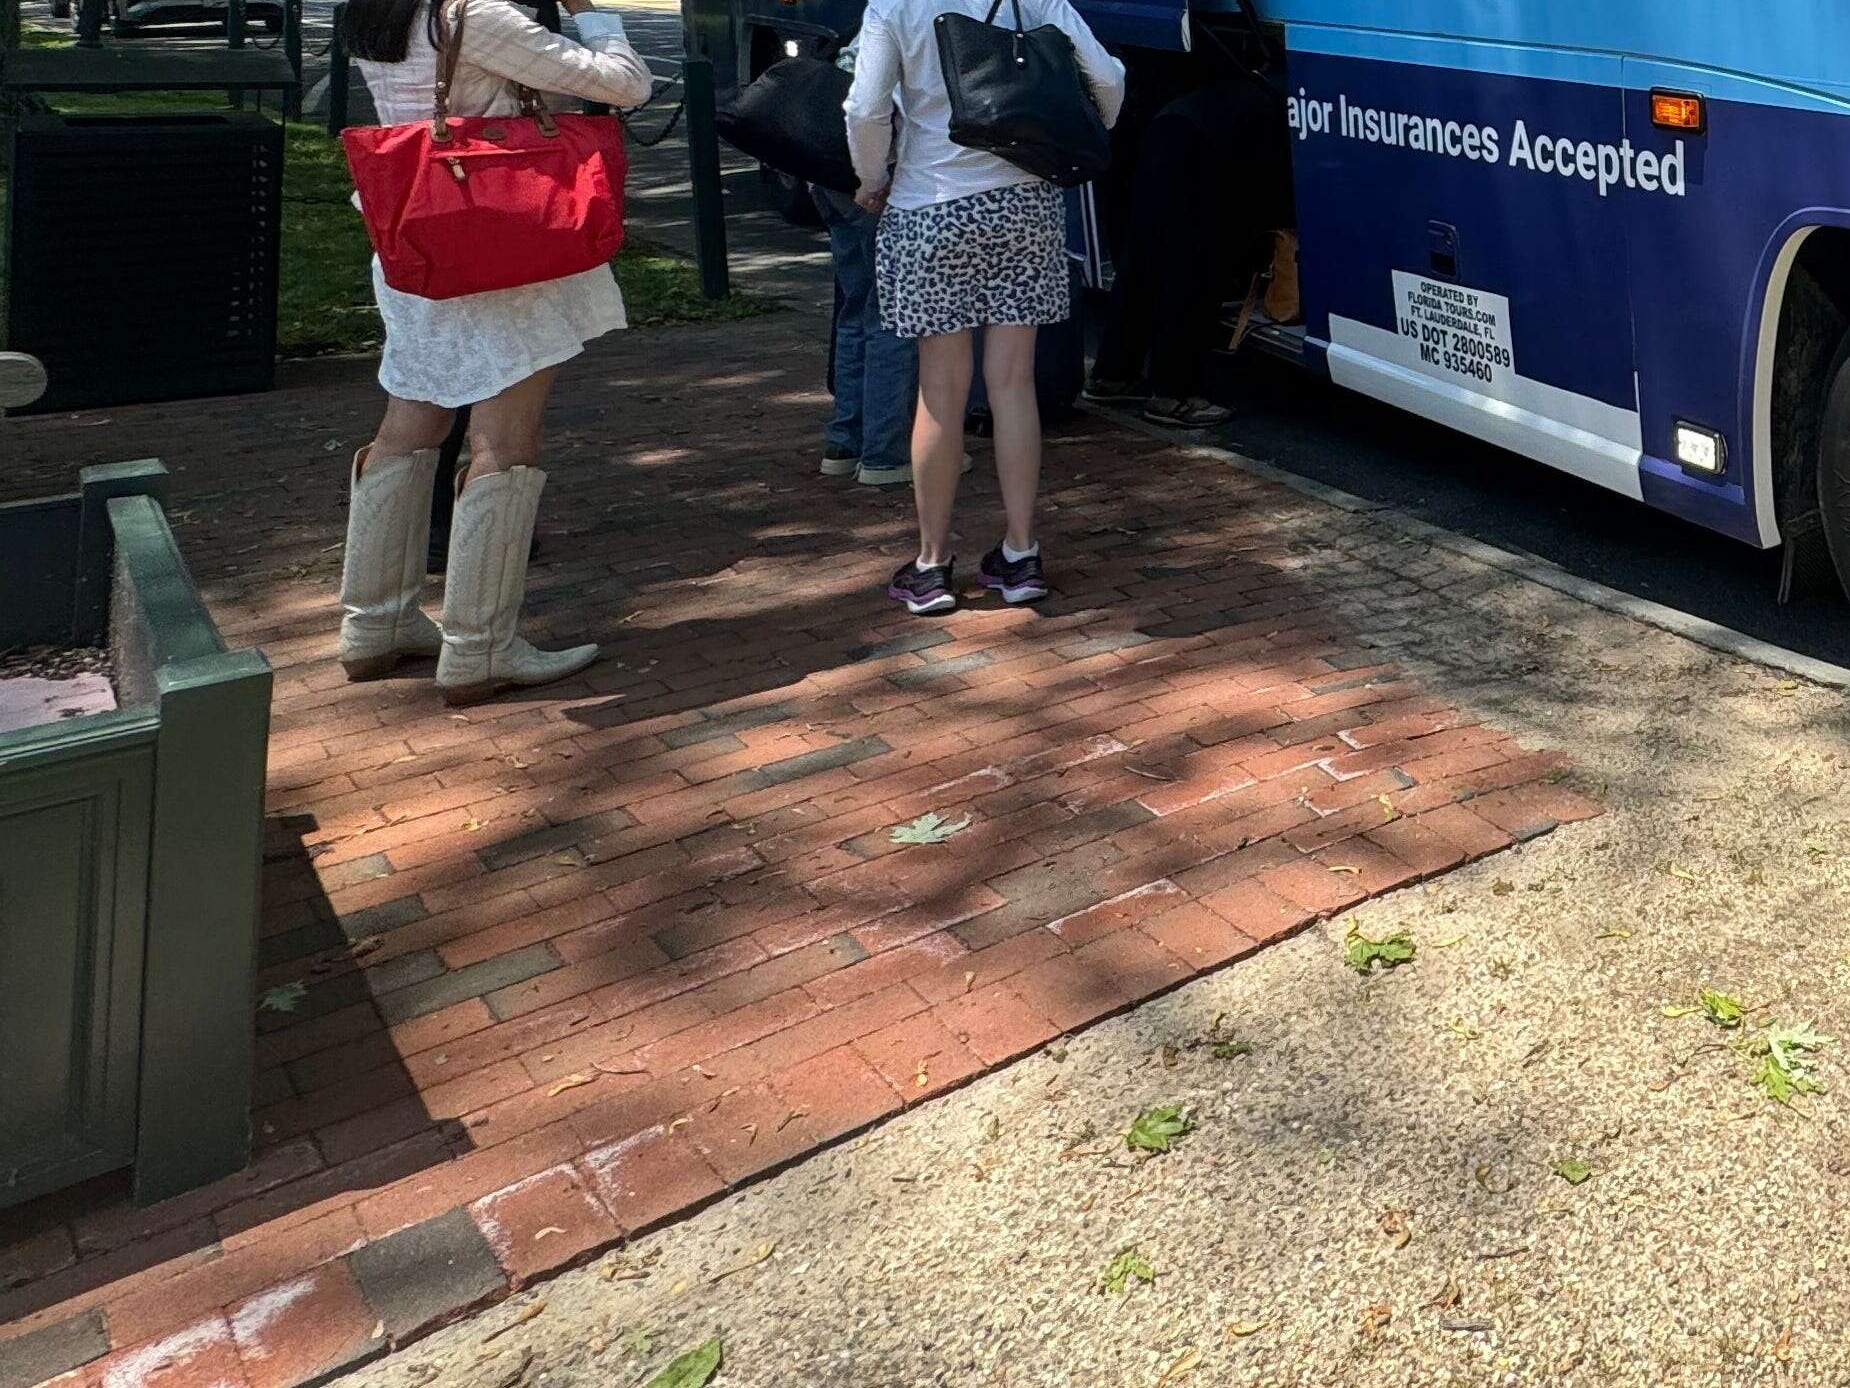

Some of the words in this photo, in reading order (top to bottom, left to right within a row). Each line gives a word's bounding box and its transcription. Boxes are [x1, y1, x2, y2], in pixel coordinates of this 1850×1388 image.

[1340, 94, 1500, 163] Insurances
[1509, 119, 1686, 196] Accepted
[1408, 291, 1442, 309] FLORIDA
[1444, 301, 1496, 327] TOURS.COM
[1420, 281, 1465, 302] OPERATED
[1467, 294, 1479, 307] BY
[1400, 317, 1418, 339] US
[1421, 324, 1448, 349] DOT
[1452, 333, 1510, 368] 2800589
[1424, 307, 1482, 338] LAUDERDALE,
[1484, 326, 1495, 340] FL
[1420, 343, 1440, 365] MC
[1443, 352, 1492, 383] 935460
